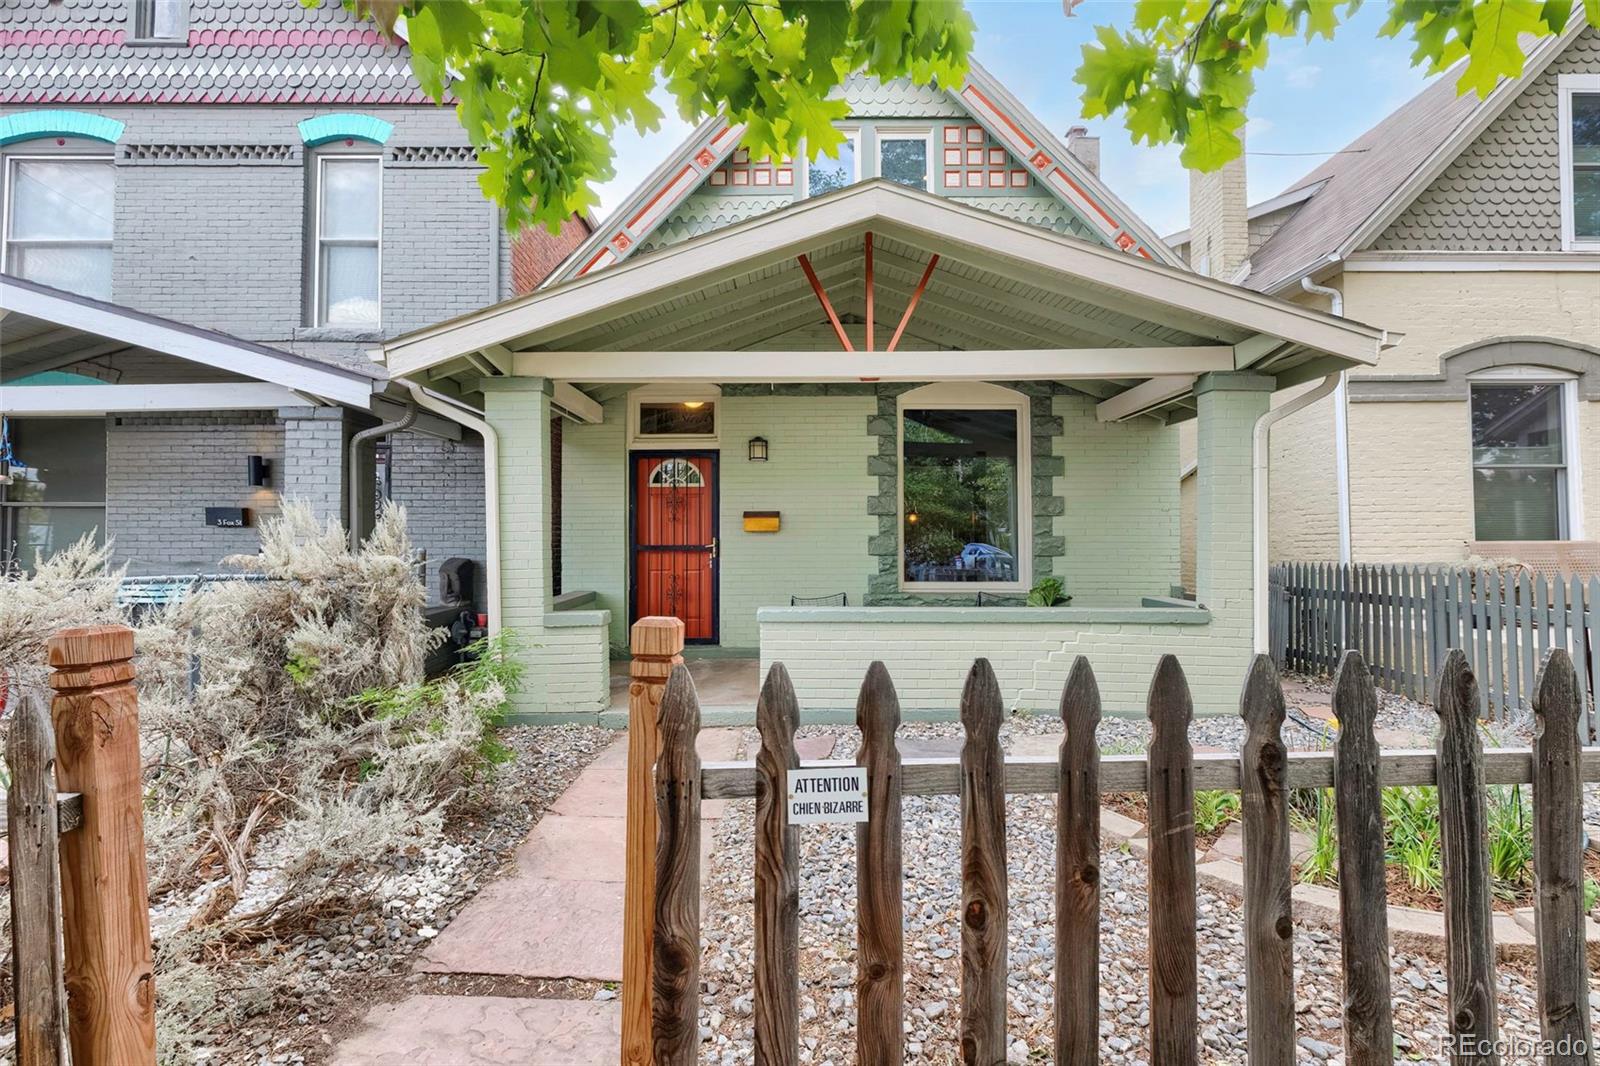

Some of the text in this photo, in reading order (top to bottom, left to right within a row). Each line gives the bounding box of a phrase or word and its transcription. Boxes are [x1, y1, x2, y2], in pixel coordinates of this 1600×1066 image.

[795, 776, 859, 793] ATTENTION
[793, 800, 864, 815] CHIEN BIZARRE
